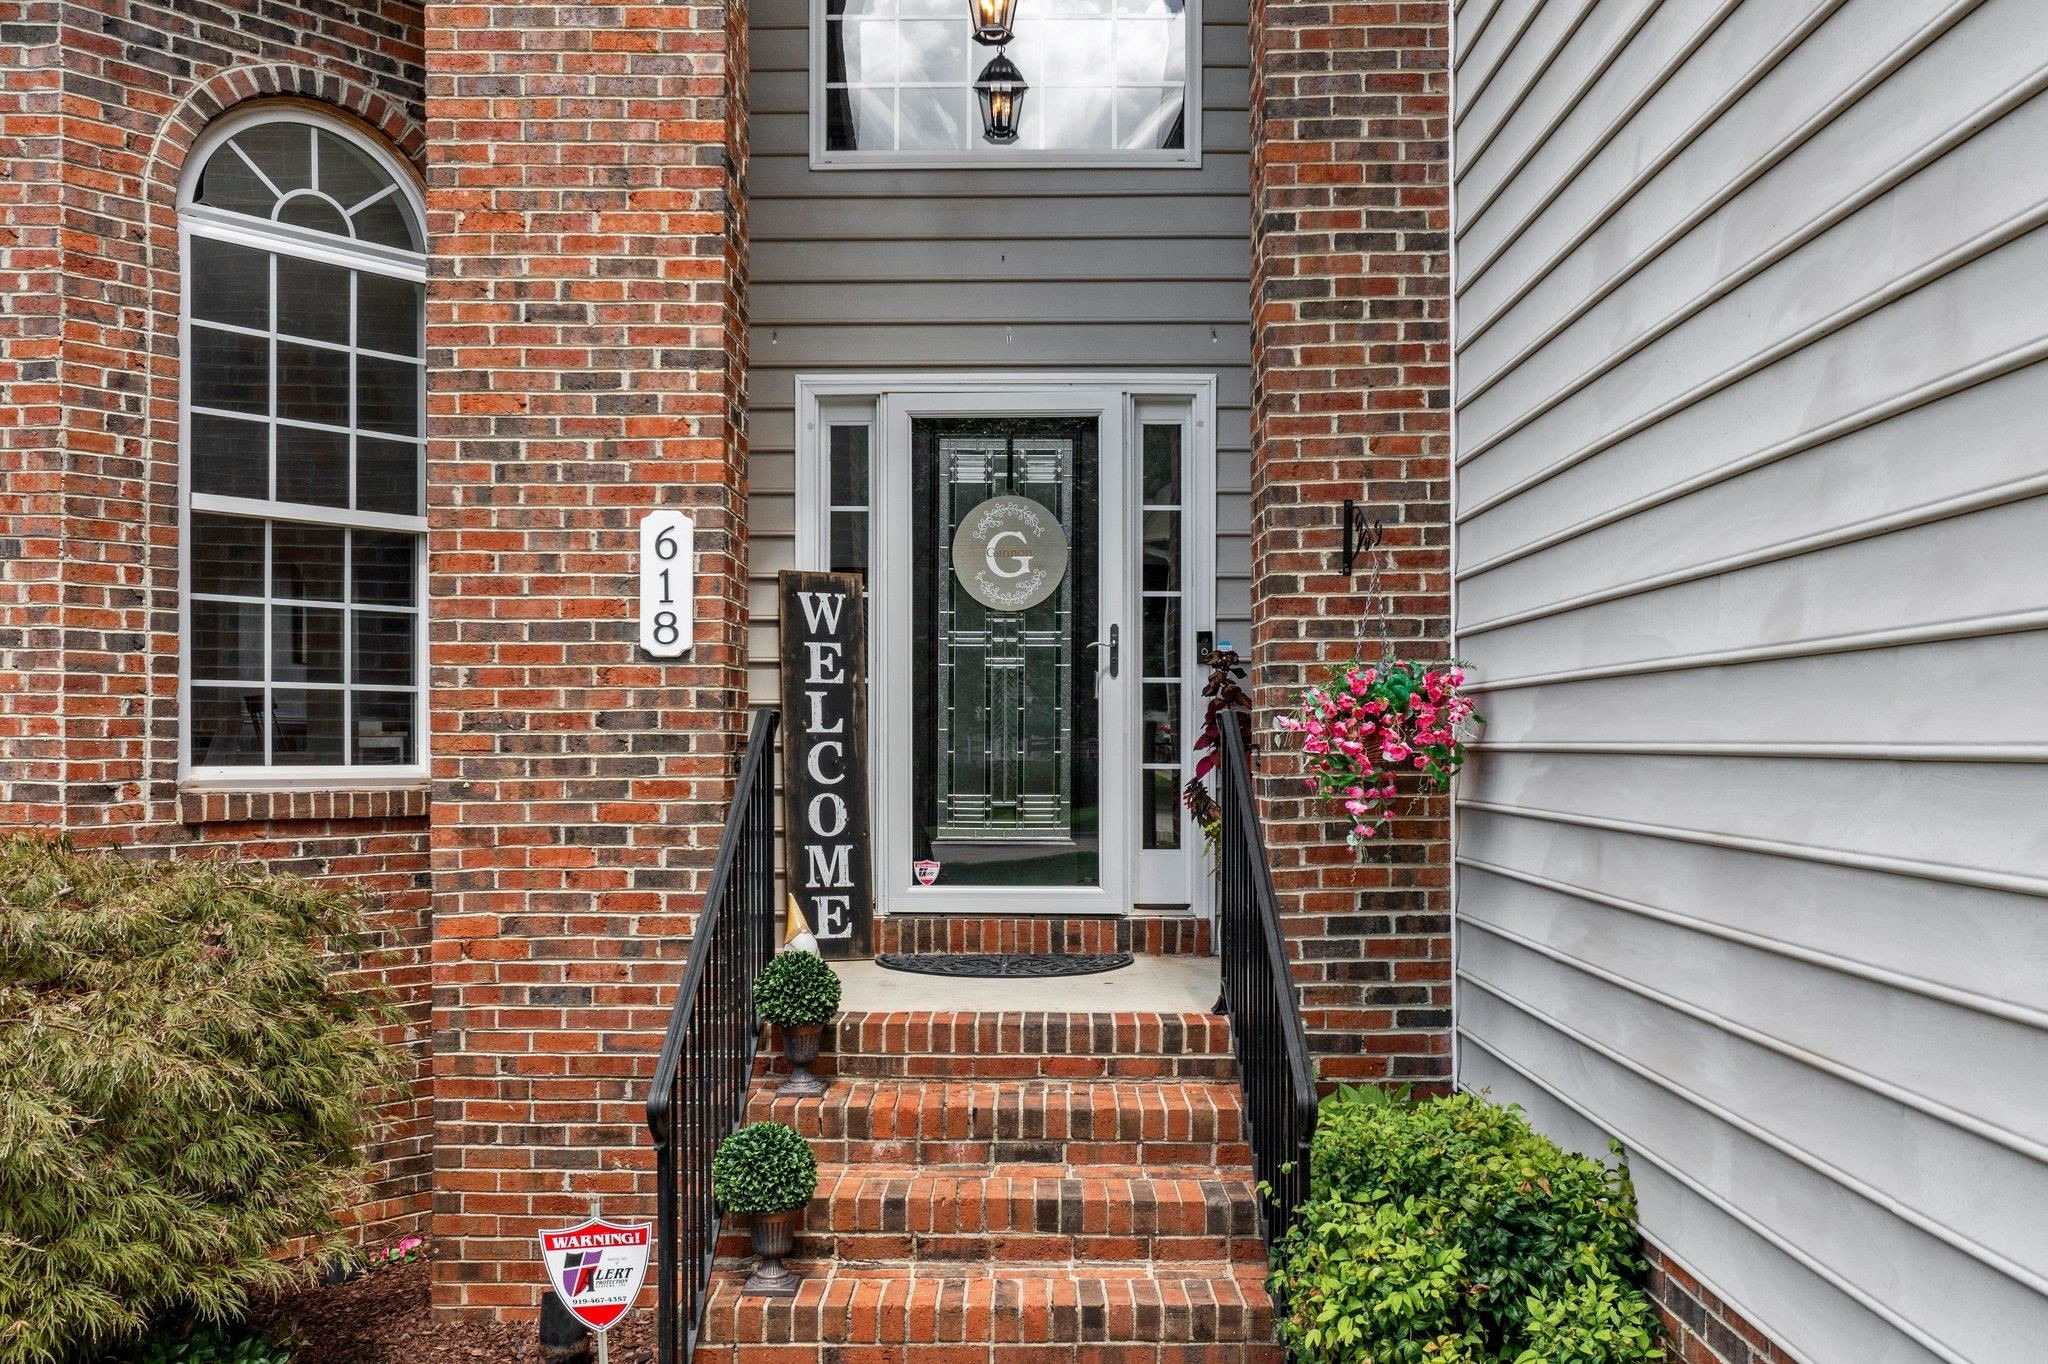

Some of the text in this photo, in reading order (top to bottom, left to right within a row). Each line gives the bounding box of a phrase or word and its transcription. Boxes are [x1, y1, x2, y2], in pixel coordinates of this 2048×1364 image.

[653, 525, 679, 645] 618
[985, 531, 1034, 578] G
[797, 592, 854, 940] WELCOME
[552, 1232, 641, 1249] WARNING!
